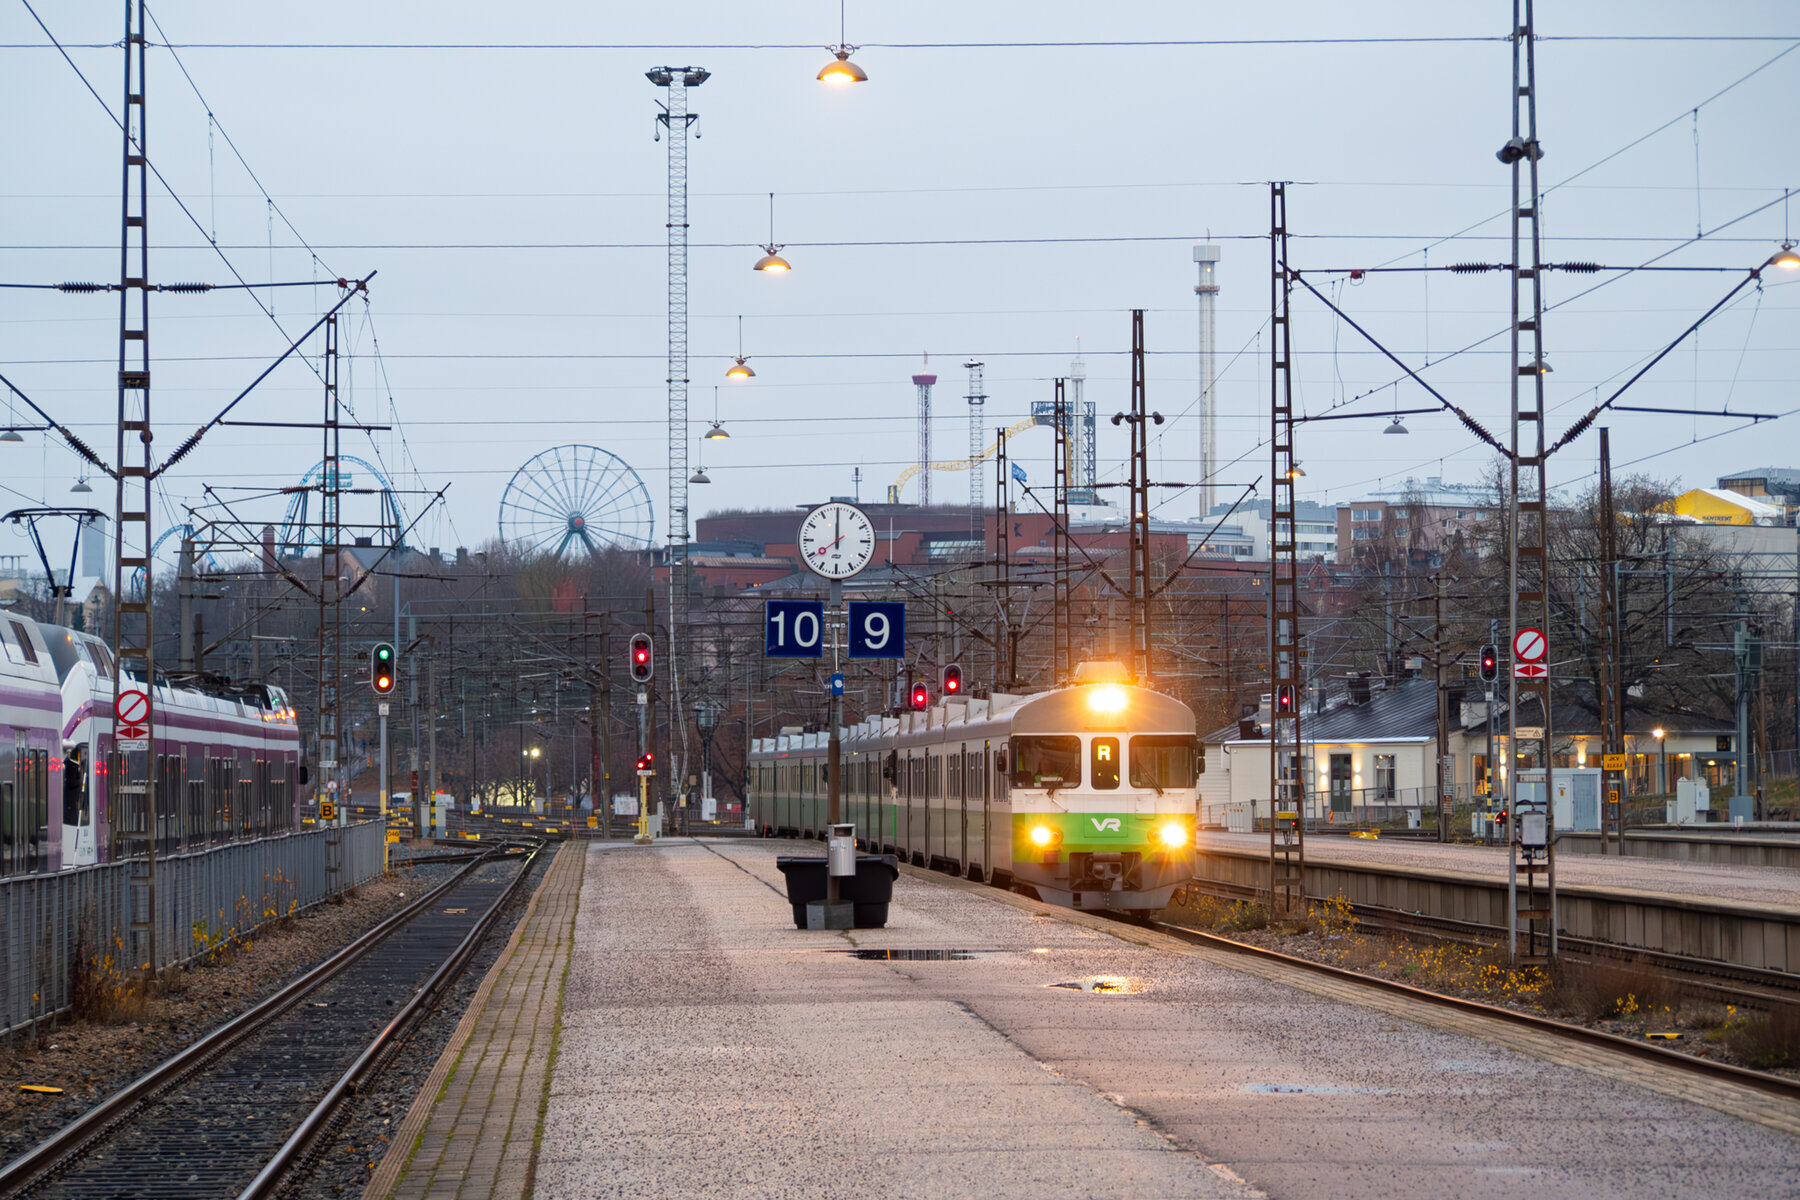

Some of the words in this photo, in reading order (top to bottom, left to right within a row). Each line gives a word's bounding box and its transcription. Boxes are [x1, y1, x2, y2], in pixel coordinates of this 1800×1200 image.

[770, 610, 819, 648] 10
[864, 612, 890, 650] 9
[1097, 745, 1111, 761] R
[1610, 792, 1617, 801] B
[322, 805, 332, 816] B
[1090, 817, 1122, 832] VR
